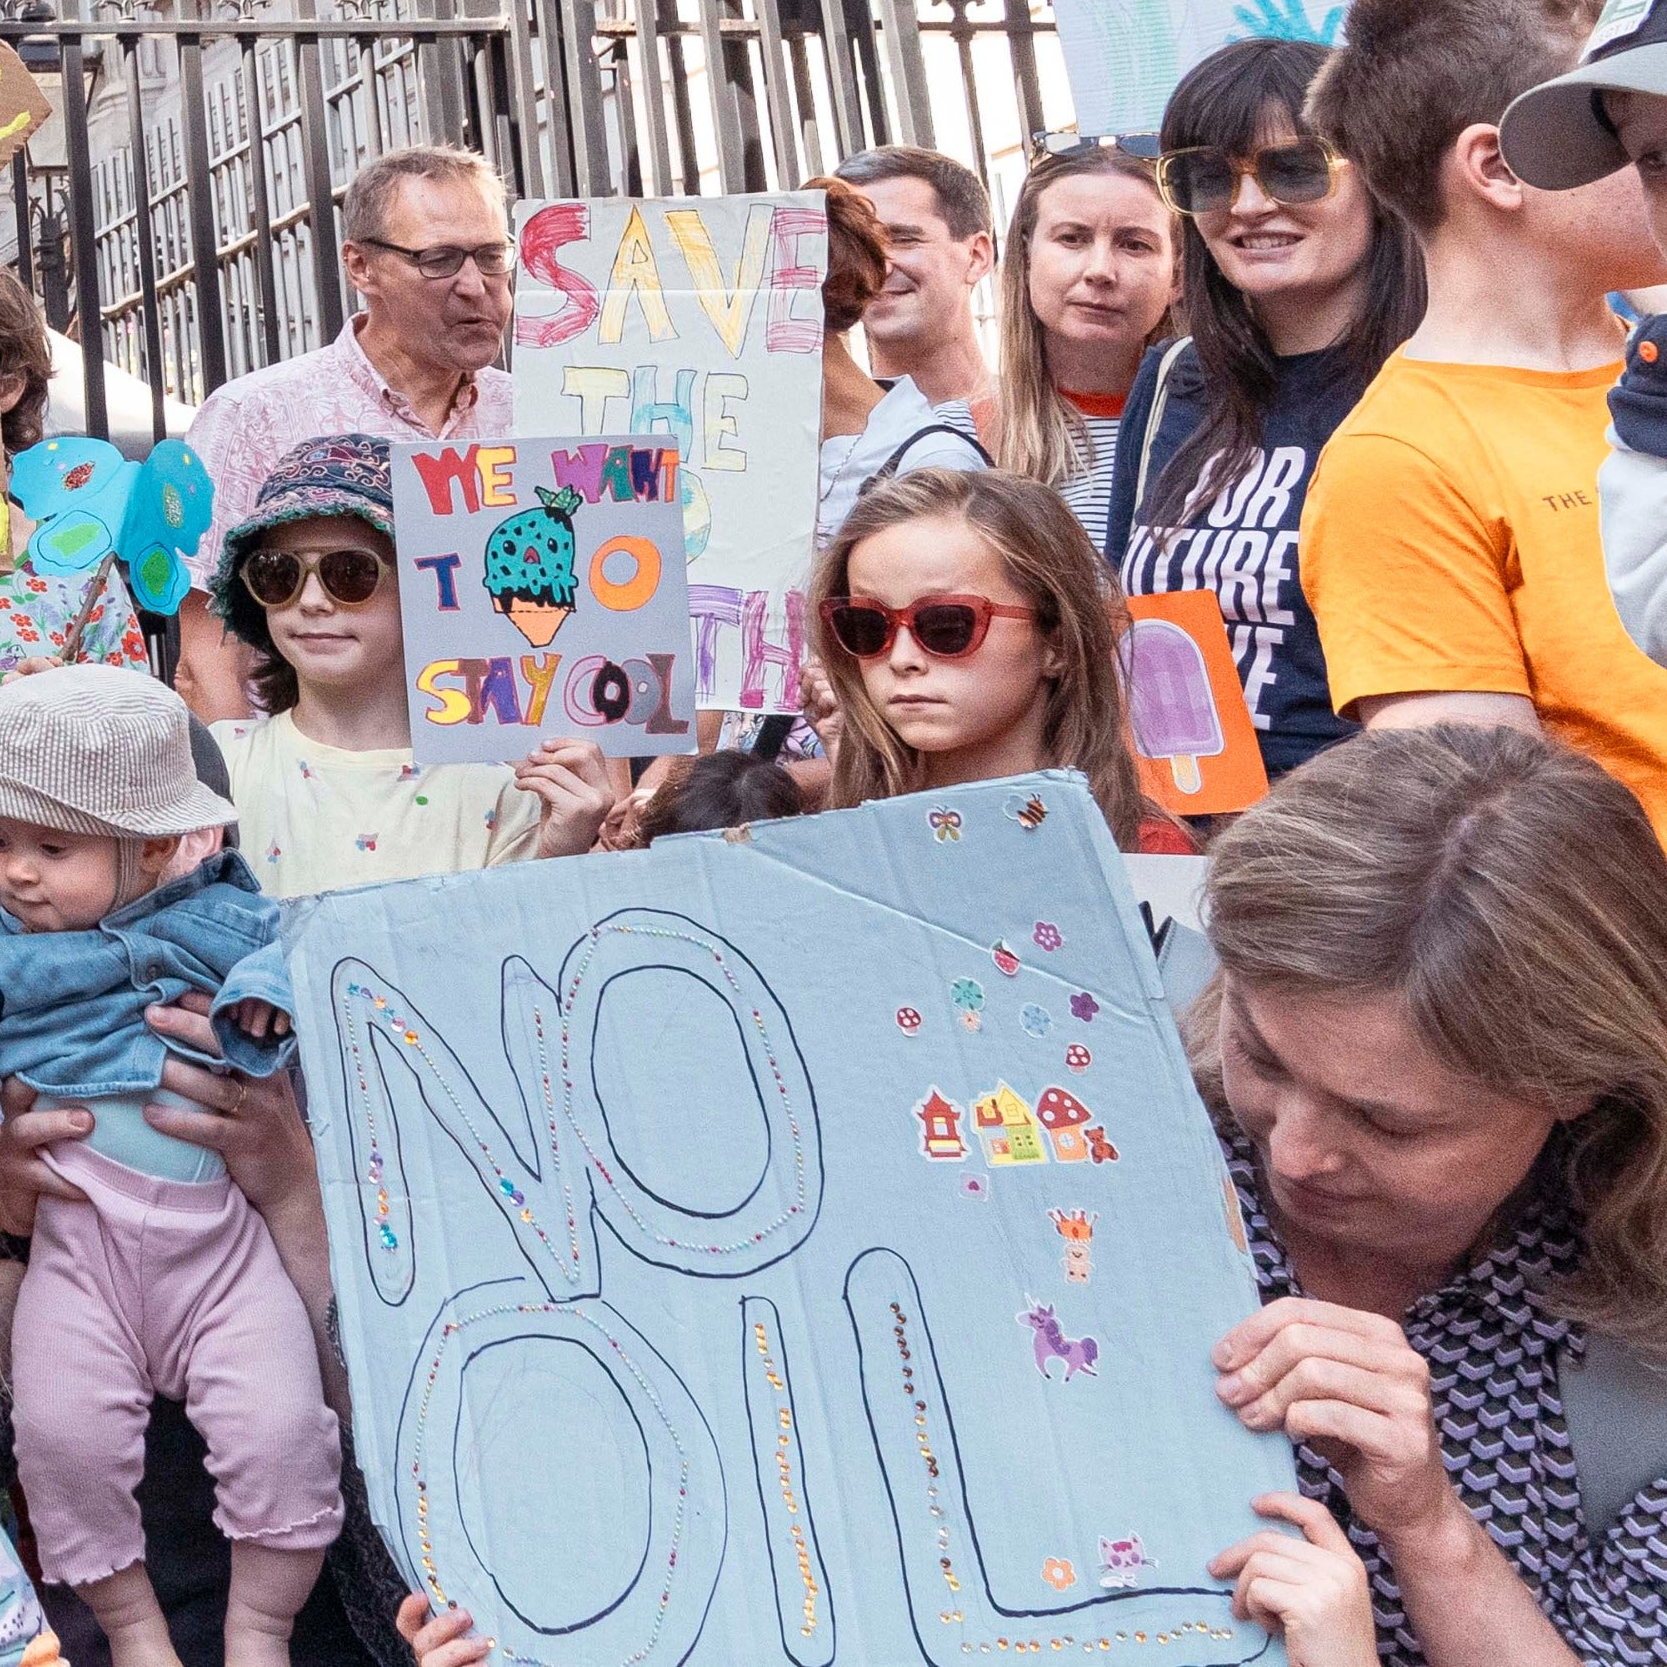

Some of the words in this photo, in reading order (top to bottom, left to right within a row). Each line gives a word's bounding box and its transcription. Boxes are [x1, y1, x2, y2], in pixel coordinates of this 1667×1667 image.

[514, 201, 827, 360] SAVE
[562, 365, 750, 472] THE
[411, 444, 517, 516] WE
[552, 444, 681, 504] WANT
[1542, 489, 1593, 512] THE
[415, 651, 563, 727] STAY
[564, 649, 692, 735] COOL
[331, 907, 825, 1306] NO
[393, 1246, 1273, 1667] OIL
